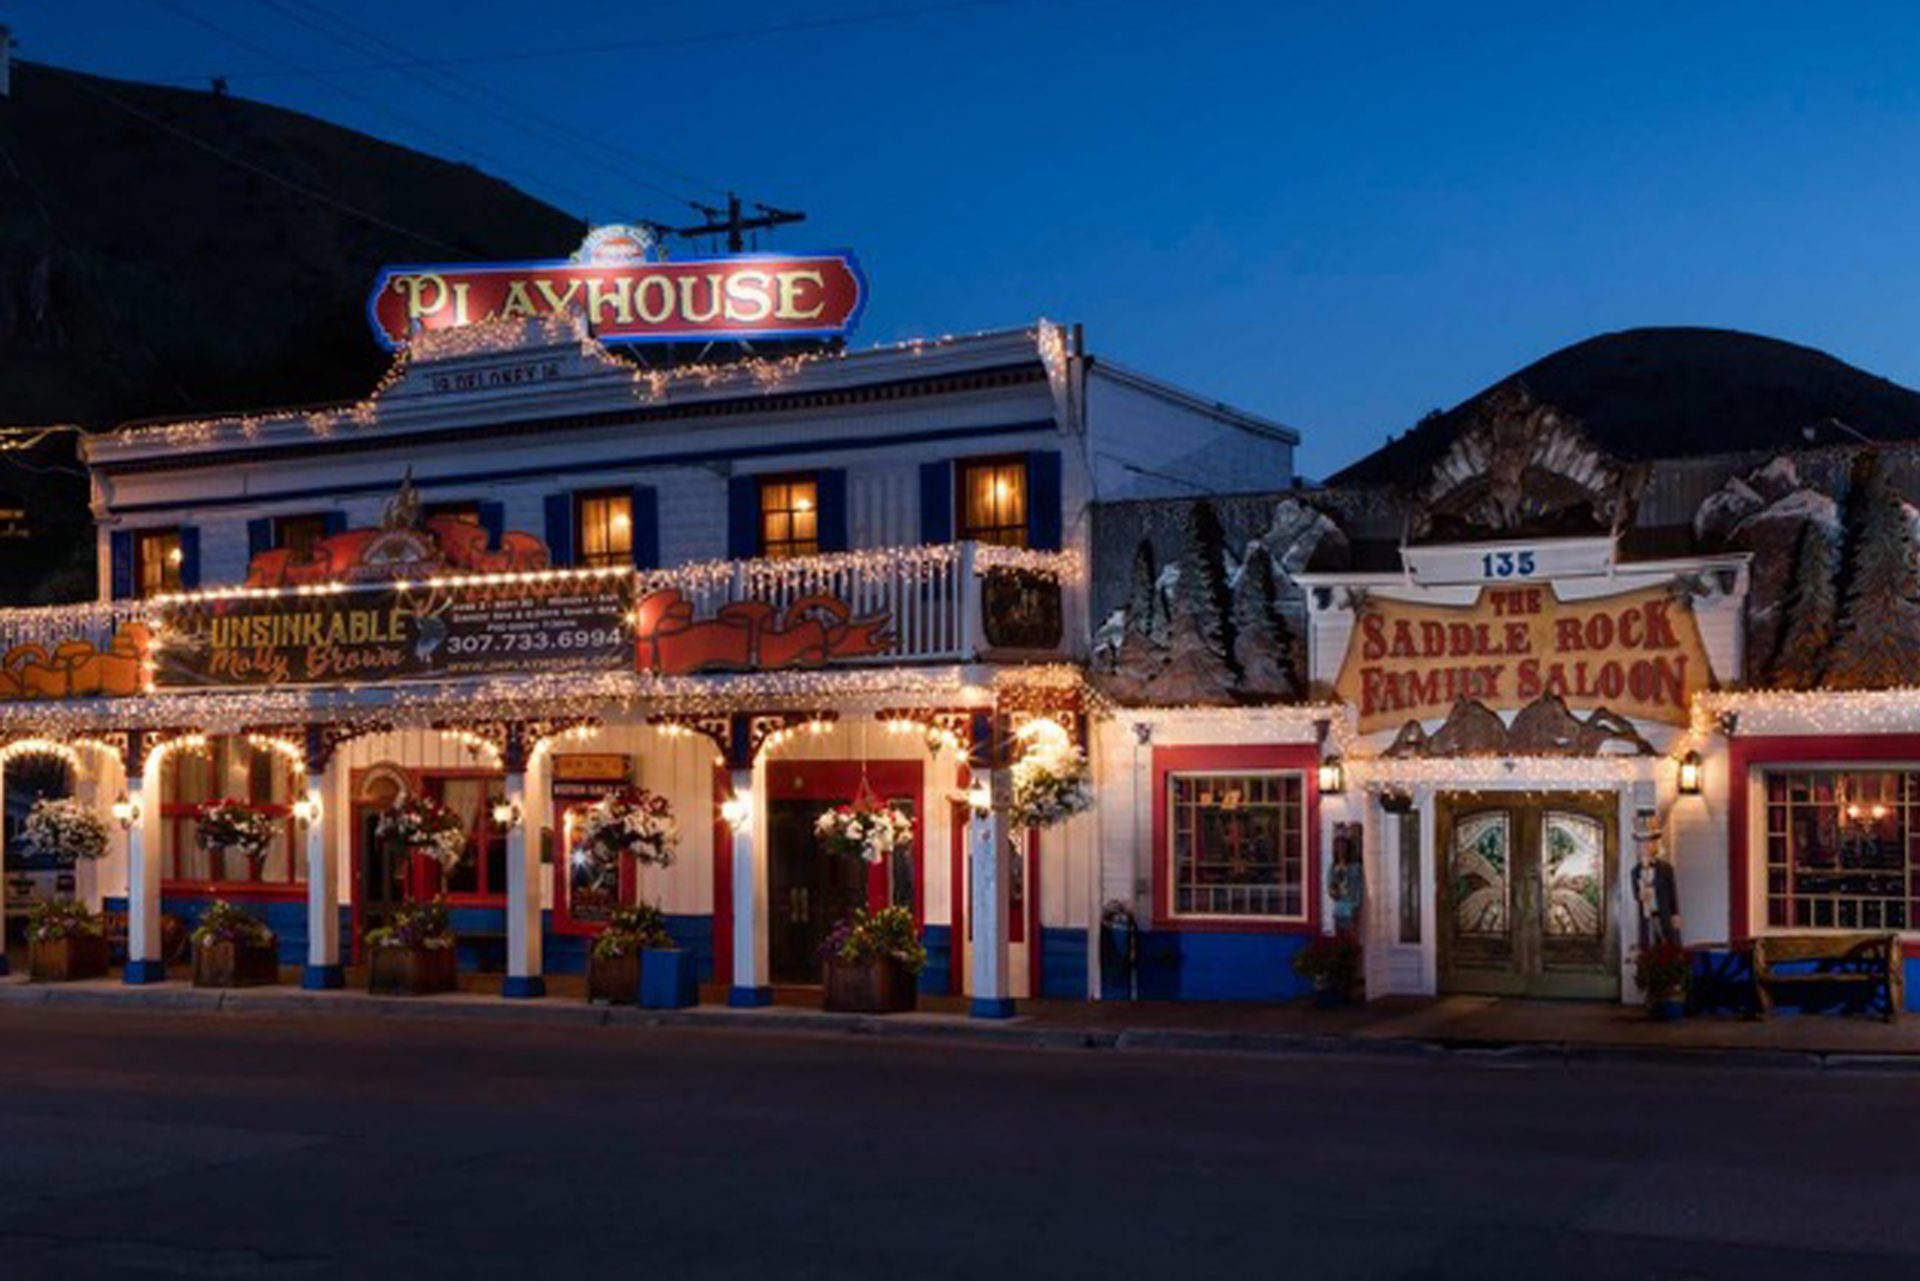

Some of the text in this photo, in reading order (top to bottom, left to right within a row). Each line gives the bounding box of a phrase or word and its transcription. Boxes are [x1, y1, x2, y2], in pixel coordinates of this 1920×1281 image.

[394, 271, 825, 326] PLAYHOUSE
[1482, 552, 1535, 577] 135
[1489, 588, 1541, 617] THE
[211, 608, 407, 648] UNSINKABLE
[448, 628, 621, 653] 307.733.6994
[1362, 600, 1681, 660] SADDLE ROCK
[209, 643, 406, 684] Molly Brown
[1360, 655, 1689, 718] FAMILY SALOON
